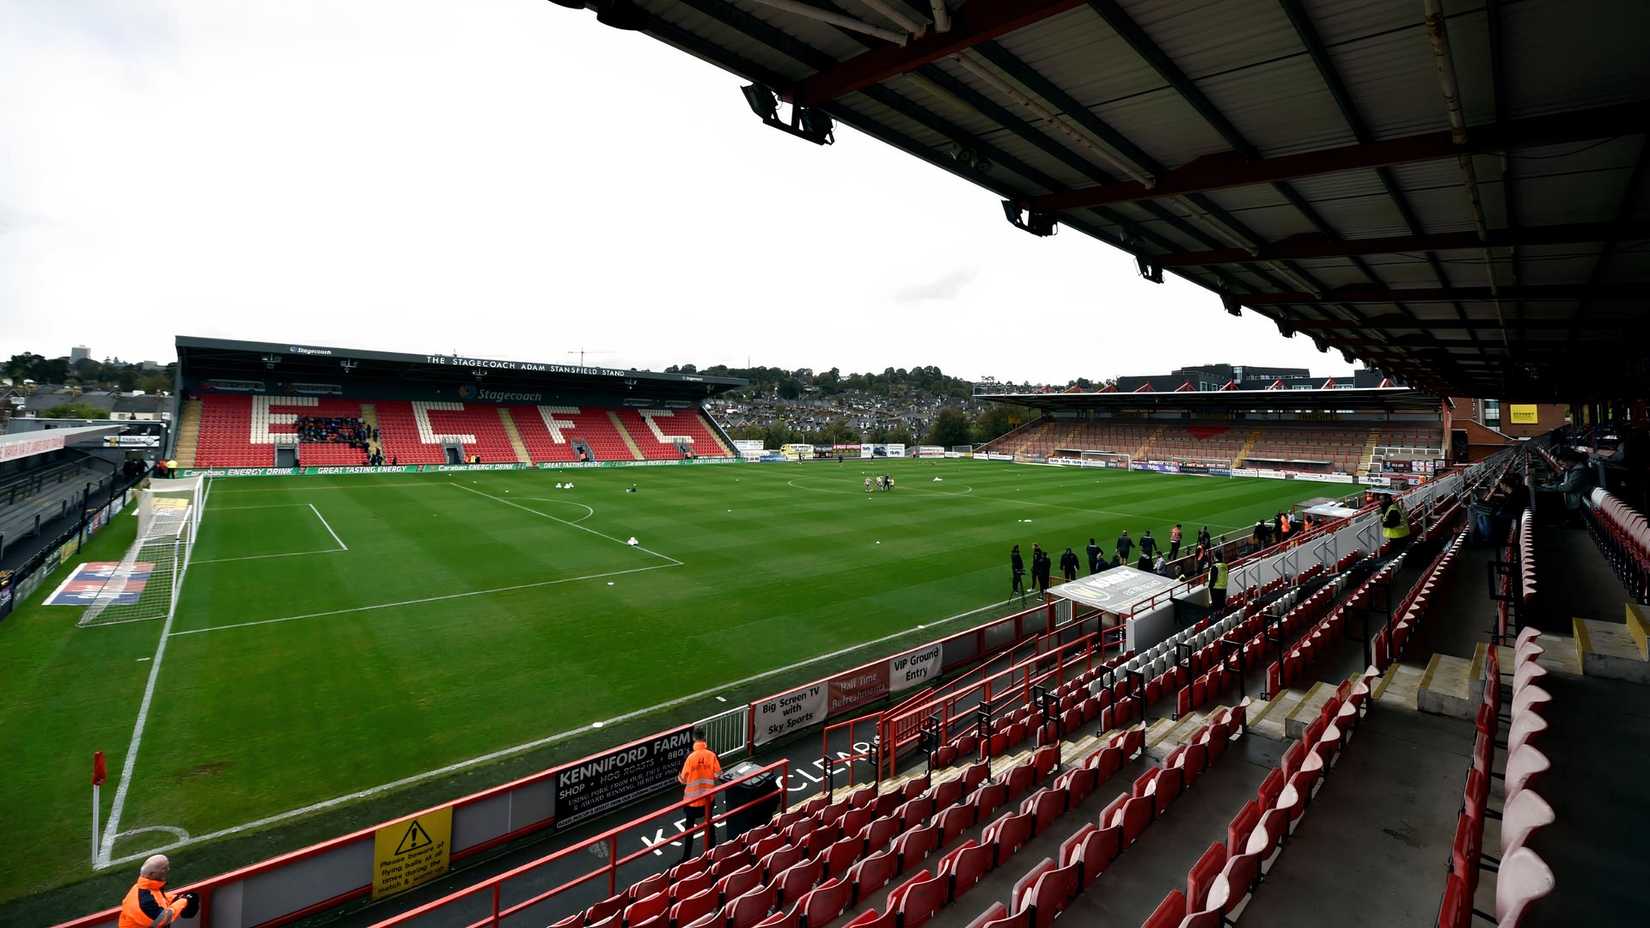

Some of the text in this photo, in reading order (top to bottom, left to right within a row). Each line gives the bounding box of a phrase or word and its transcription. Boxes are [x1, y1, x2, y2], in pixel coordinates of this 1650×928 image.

[427, 356, 625, 377] THE STAGECOACH ADAM STANSFIELD STAND
[479, 388, 542, 402] Stagecoach
[227, 468, 263, 476] ENERGY
[265, 467, 293, 475] DRINK
[317, 465, 407, 474] GREAT TASTING ENERGY
[894, 648, 939, 672] VIP Ground
[905, 666, 928, 682] Entry
[762, 686, 821, 715] Big Screen TV
[782, 703, 802, 717] with
[768, 711, 814, 736] Sky Sports
[559, 746, 648, 788] KENNIFORD
[653, 732, 691, 755] FARM
[559, 783, 585, 800] SHOP
